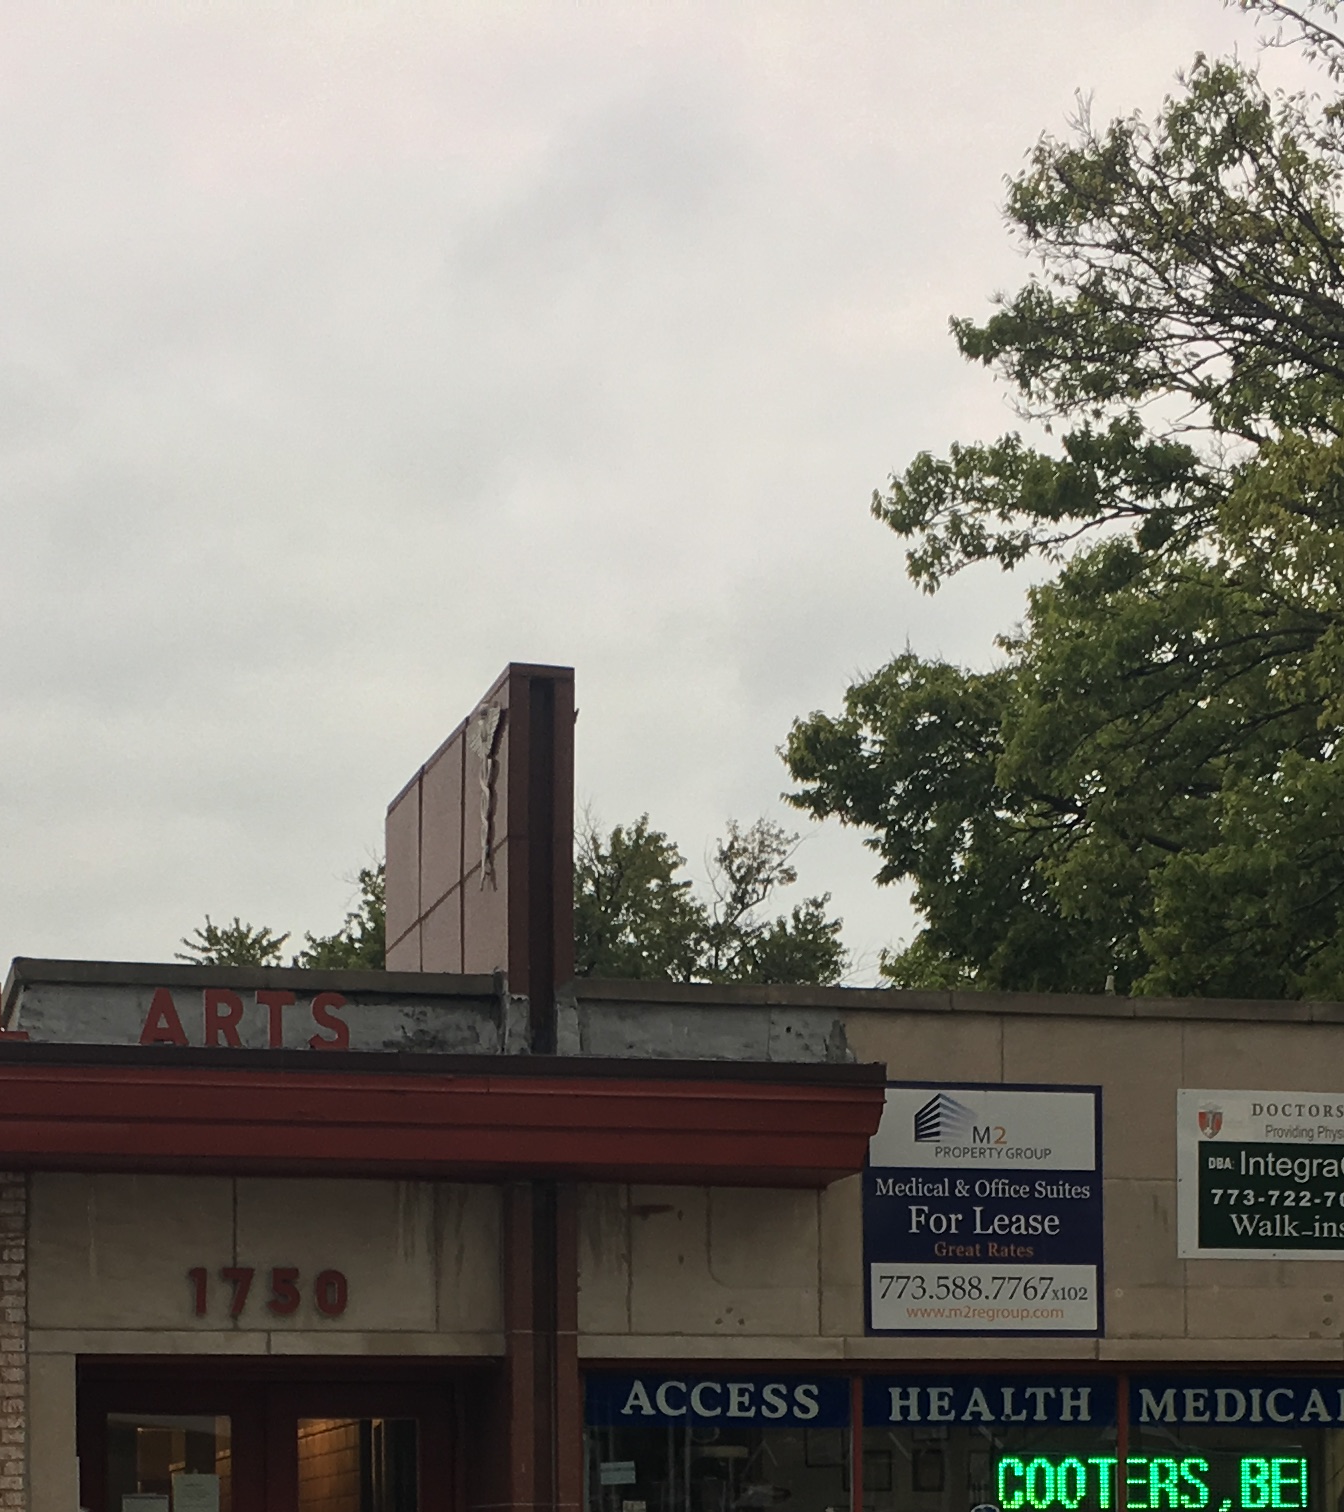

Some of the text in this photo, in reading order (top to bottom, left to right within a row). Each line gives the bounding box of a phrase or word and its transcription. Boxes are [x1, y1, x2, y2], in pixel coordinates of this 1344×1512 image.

[139, 988, 351, 1049] ARTS
[1251, 1103, 1344, 1119] DOCTORS
[972, 1126, 1007, 1145] M2
[1265, 1124, 1314, 1141] Providing
[935, 1146, 1052, 1161] PROPERTY GROUP
[876, 1178, 1090, 1199] Medical & Office Suites
[908, 1206, 1060, 1235] For Lease
[934, 1242, 1034, 1258] Great Rates
[189, 1267, 350, 1317] 1750
[906, 1307, 1064, 1322] www.m2regroup.com
[620, 1379, 821, 1420] ACCESS
[888, 1386, 1093, 1422] HEALTH
